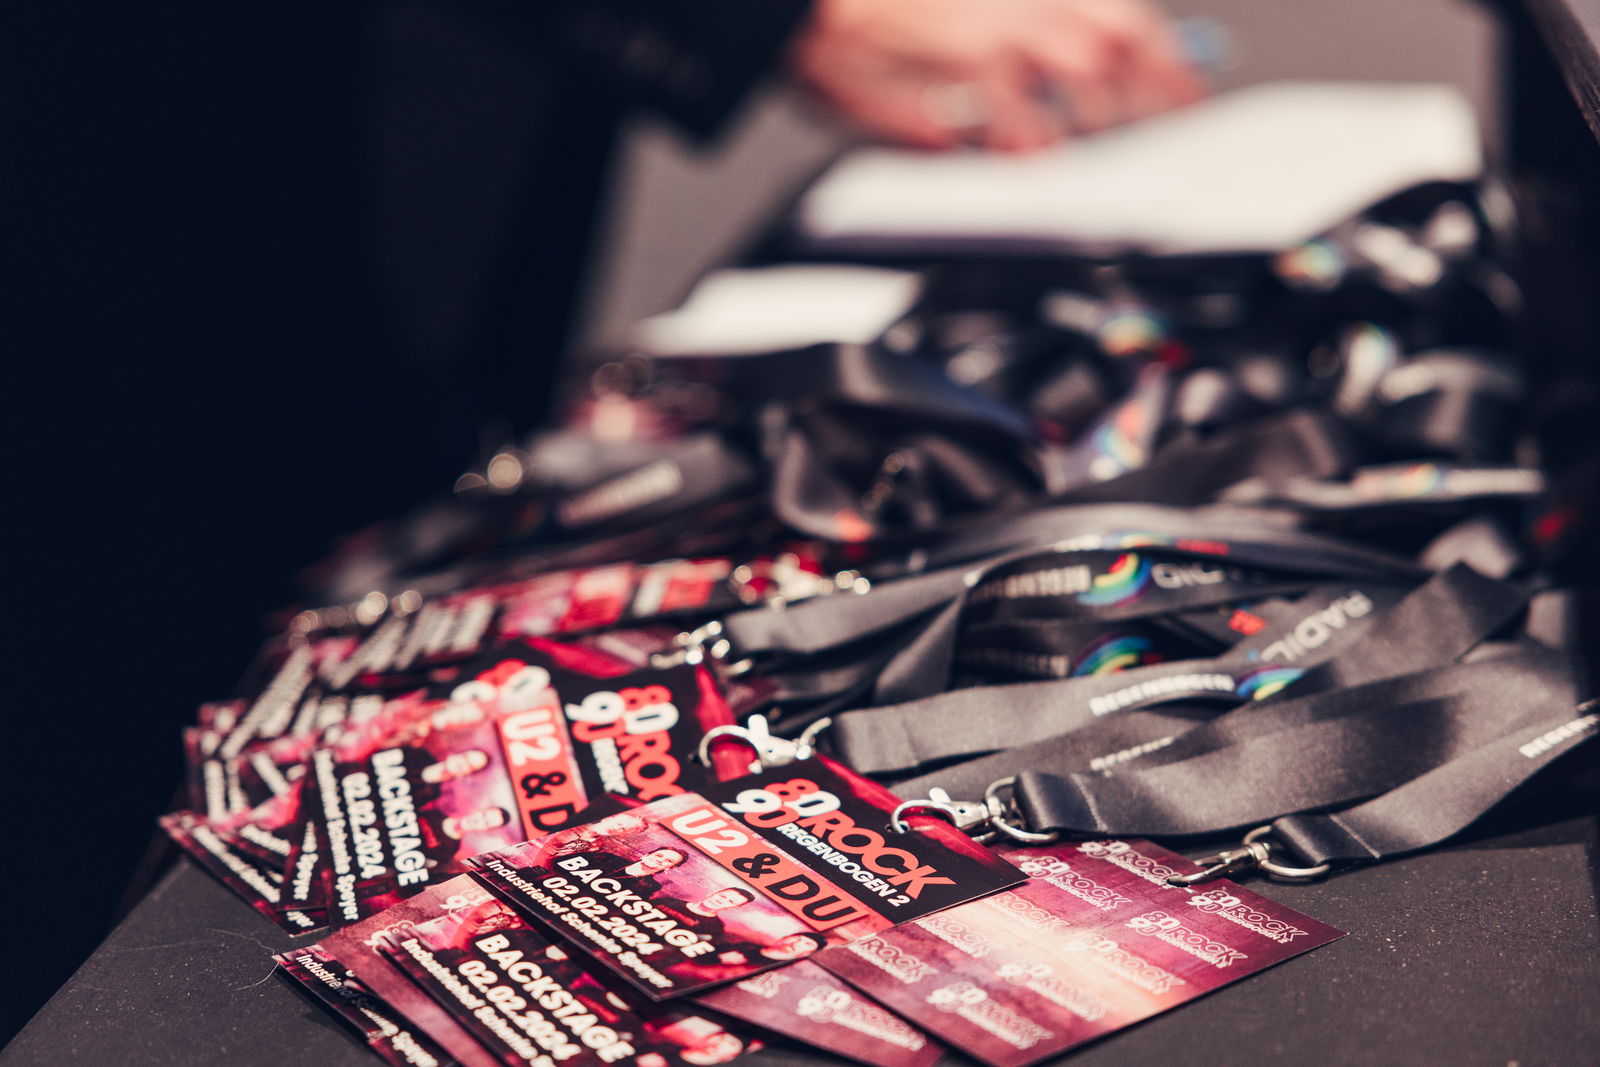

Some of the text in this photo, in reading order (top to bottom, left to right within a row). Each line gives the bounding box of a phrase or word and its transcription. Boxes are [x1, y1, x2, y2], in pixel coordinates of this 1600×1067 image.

[618, 684, 679, 735] 80
[371, 748, 429, 887] BACKSTAGE
[502, 708, 576, 832] U2 & D
[342, 771, 387, 880] 02.02.2024
[671, 809, 858, 922] U2 & DU
[722, 788, 911, 907] 90 REGENBOGEN 2
[764, 777, 957, 900] 80 ROCK
[335, 874, 359, 920] Speyer
[485, 859, 674, 988] Industriehof Schenke Speyer
[542, 876, 664, 955] 02.02.2024
[556, 855, 715, 958] BACKSTAGE
[1052, 870, 1133, 909] ROCK
[1225, 903, 1309, 942] ROCK
[475, 933, 636, 1063] BACKSTAGE
[1164, 926, 1249, 966] ROCK
[458, 960, 582, 1061] 02.02.2024
